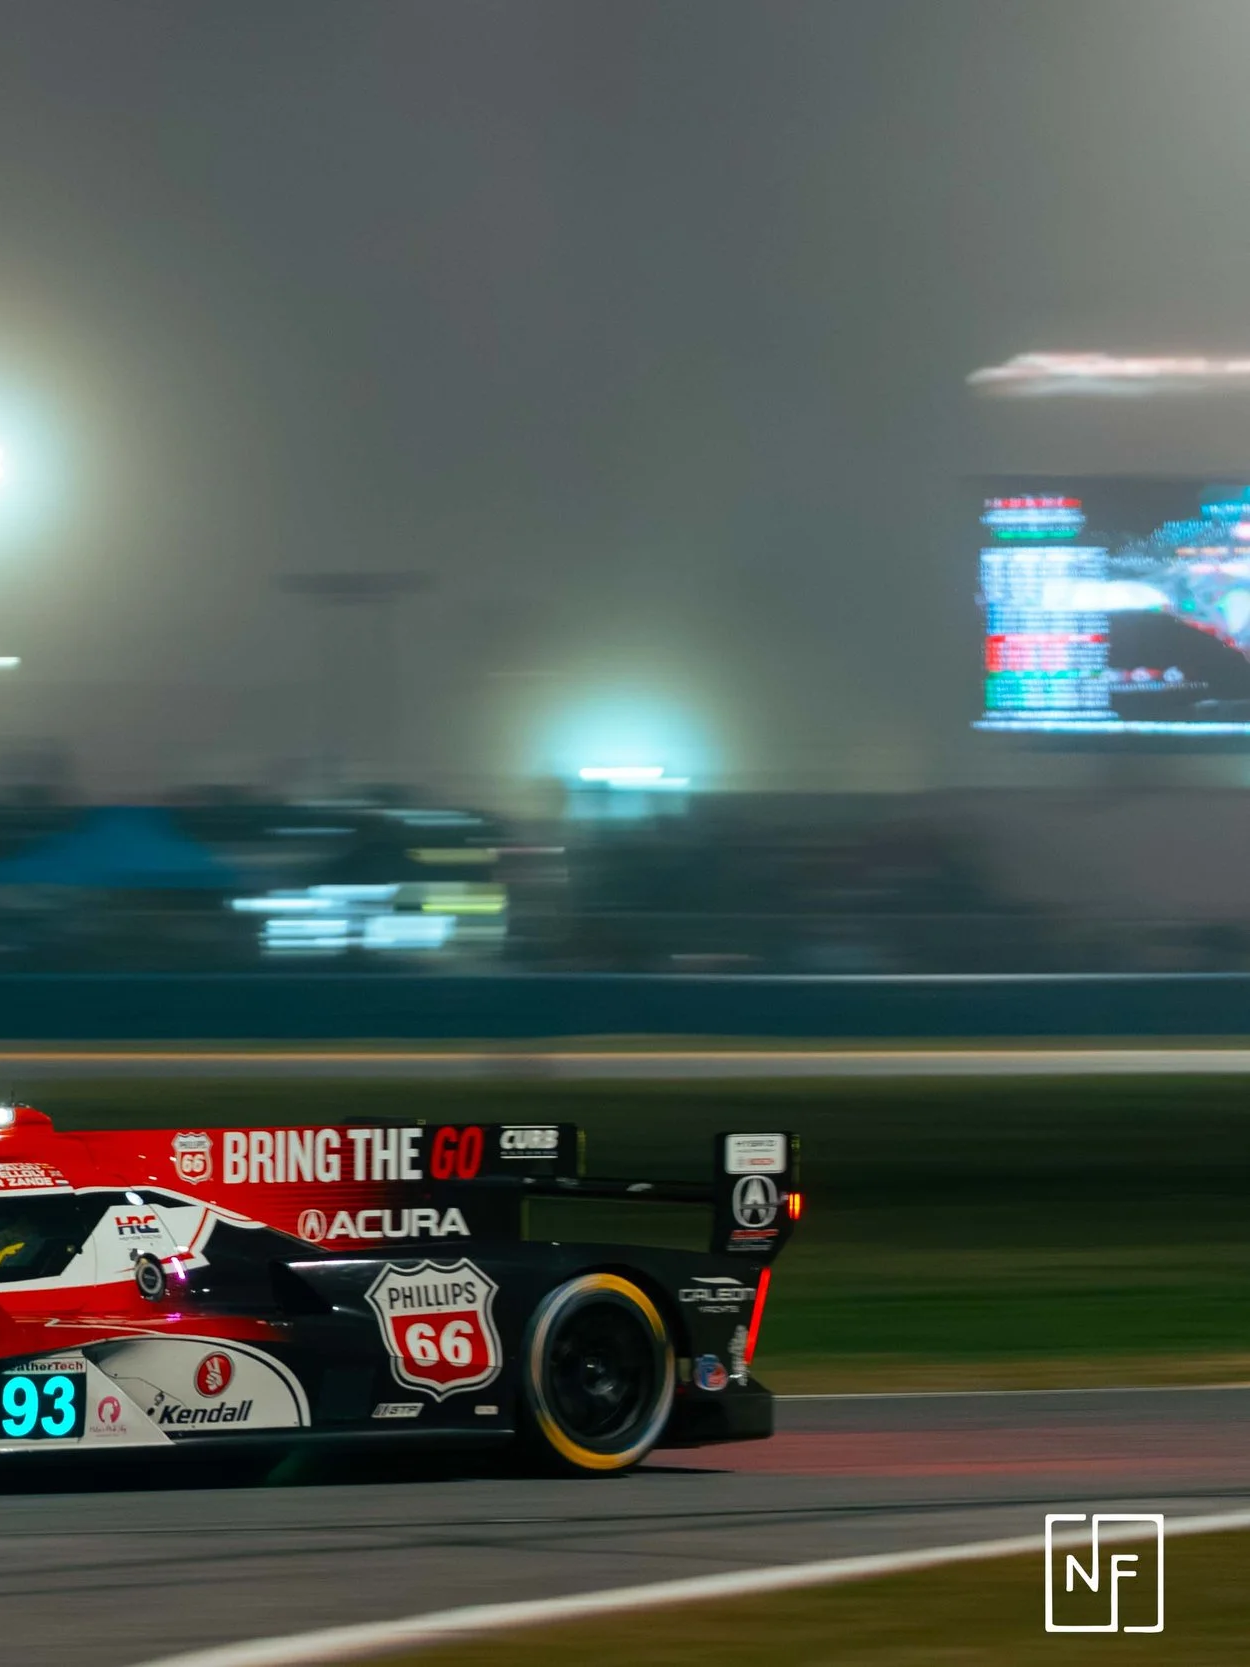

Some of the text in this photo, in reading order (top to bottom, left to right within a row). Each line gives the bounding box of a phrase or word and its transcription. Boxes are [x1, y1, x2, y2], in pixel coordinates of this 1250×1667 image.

[500, 1130, 559, 1149] CURB
[182, 1154, 205, 1173] 66
[223, 1126, 484, 1184] BRING THE GO
[6, 1177, 54, 1187] ZANDE
[115, 1215, 160, 1235] HRC
[327, 1208, 471, 1240] ACURA
[387, 1281, 478, 1310] PHILLIPS
[405, 1319, 475, 1368] 66
[2, 1375, 76, 1437] 93
[158, 1399, 253, 1424] Kendall
